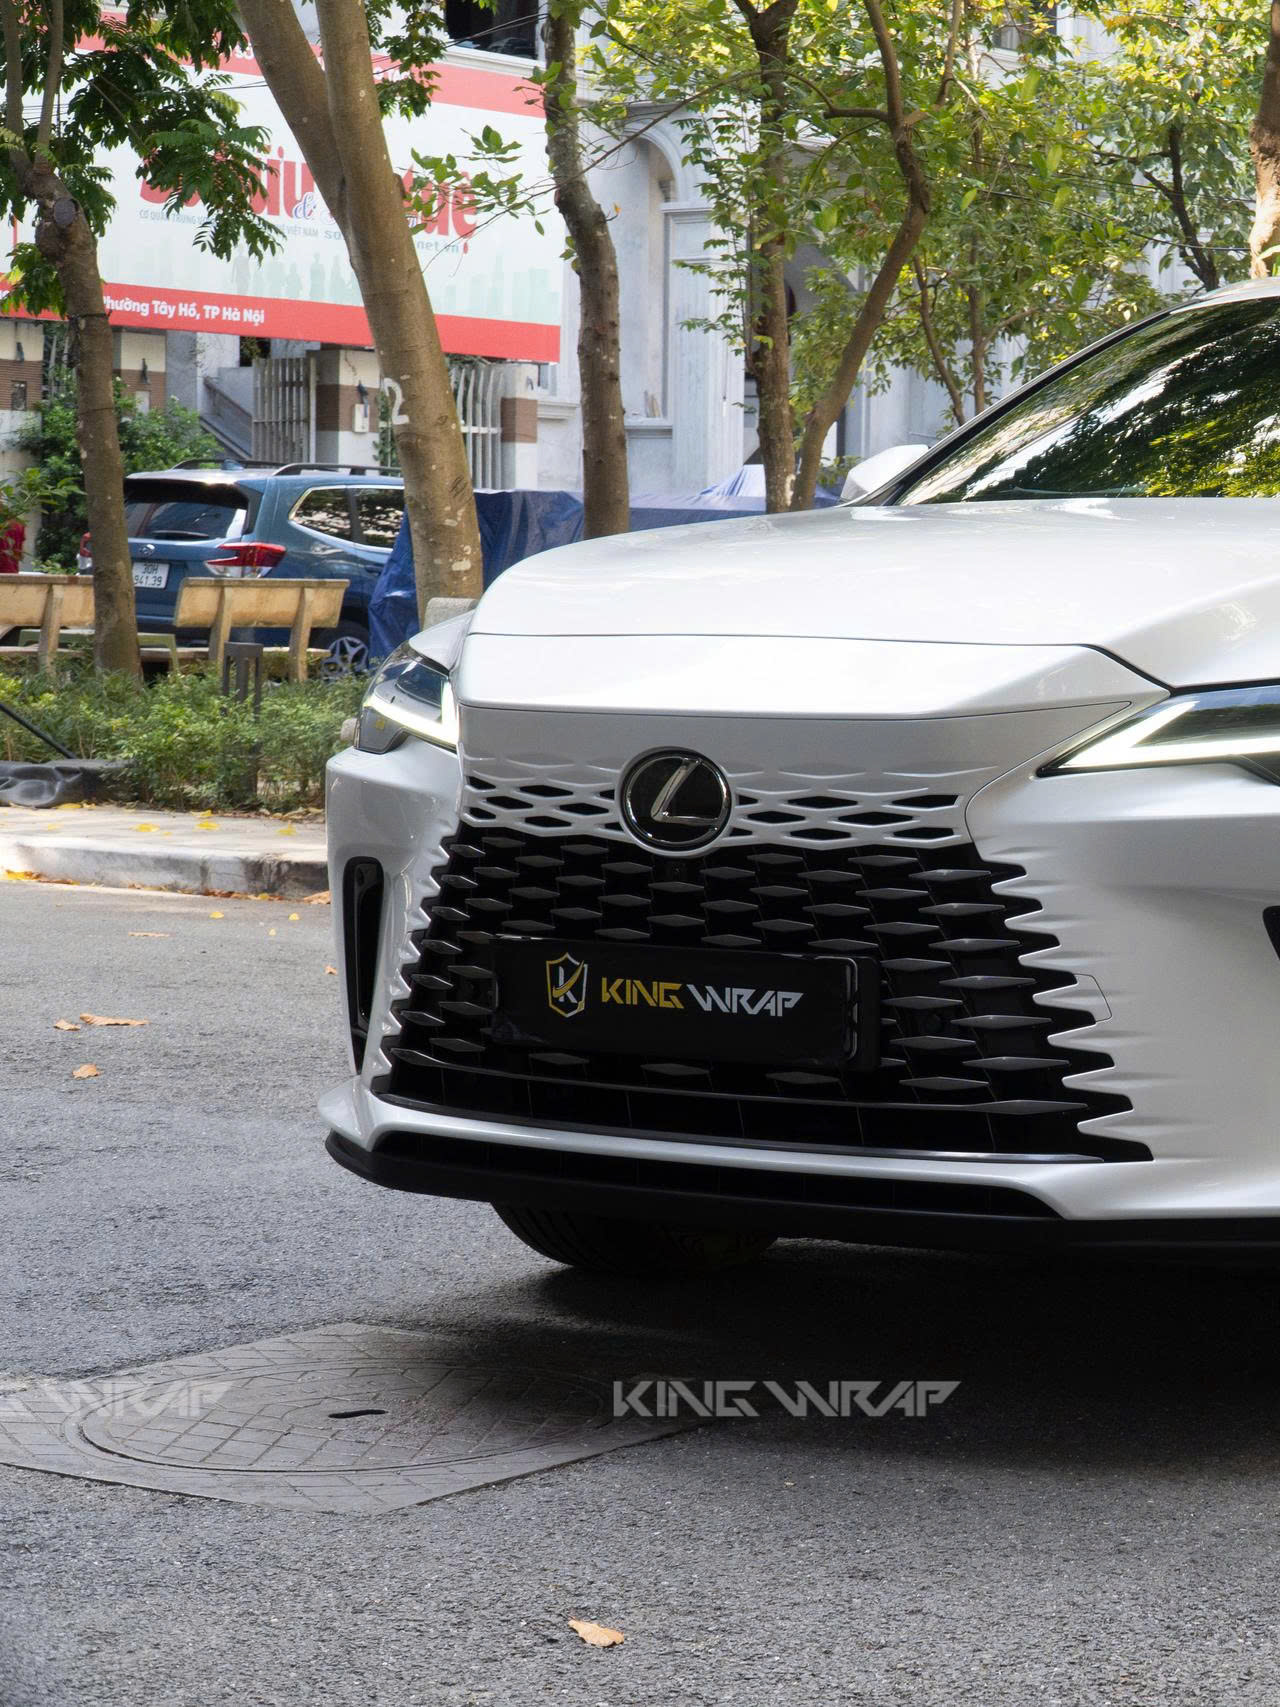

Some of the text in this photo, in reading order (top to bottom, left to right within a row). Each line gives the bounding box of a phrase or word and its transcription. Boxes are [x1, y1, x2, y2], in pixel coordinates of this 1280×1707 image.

[152, 300, 176, 319] Tây
[203, 305, 220, 318] TP
[222, 306, 240, 321] Hà
[243, 308, 265, 327] Nội
[601, 976, 804, 1017] KING WRAP
